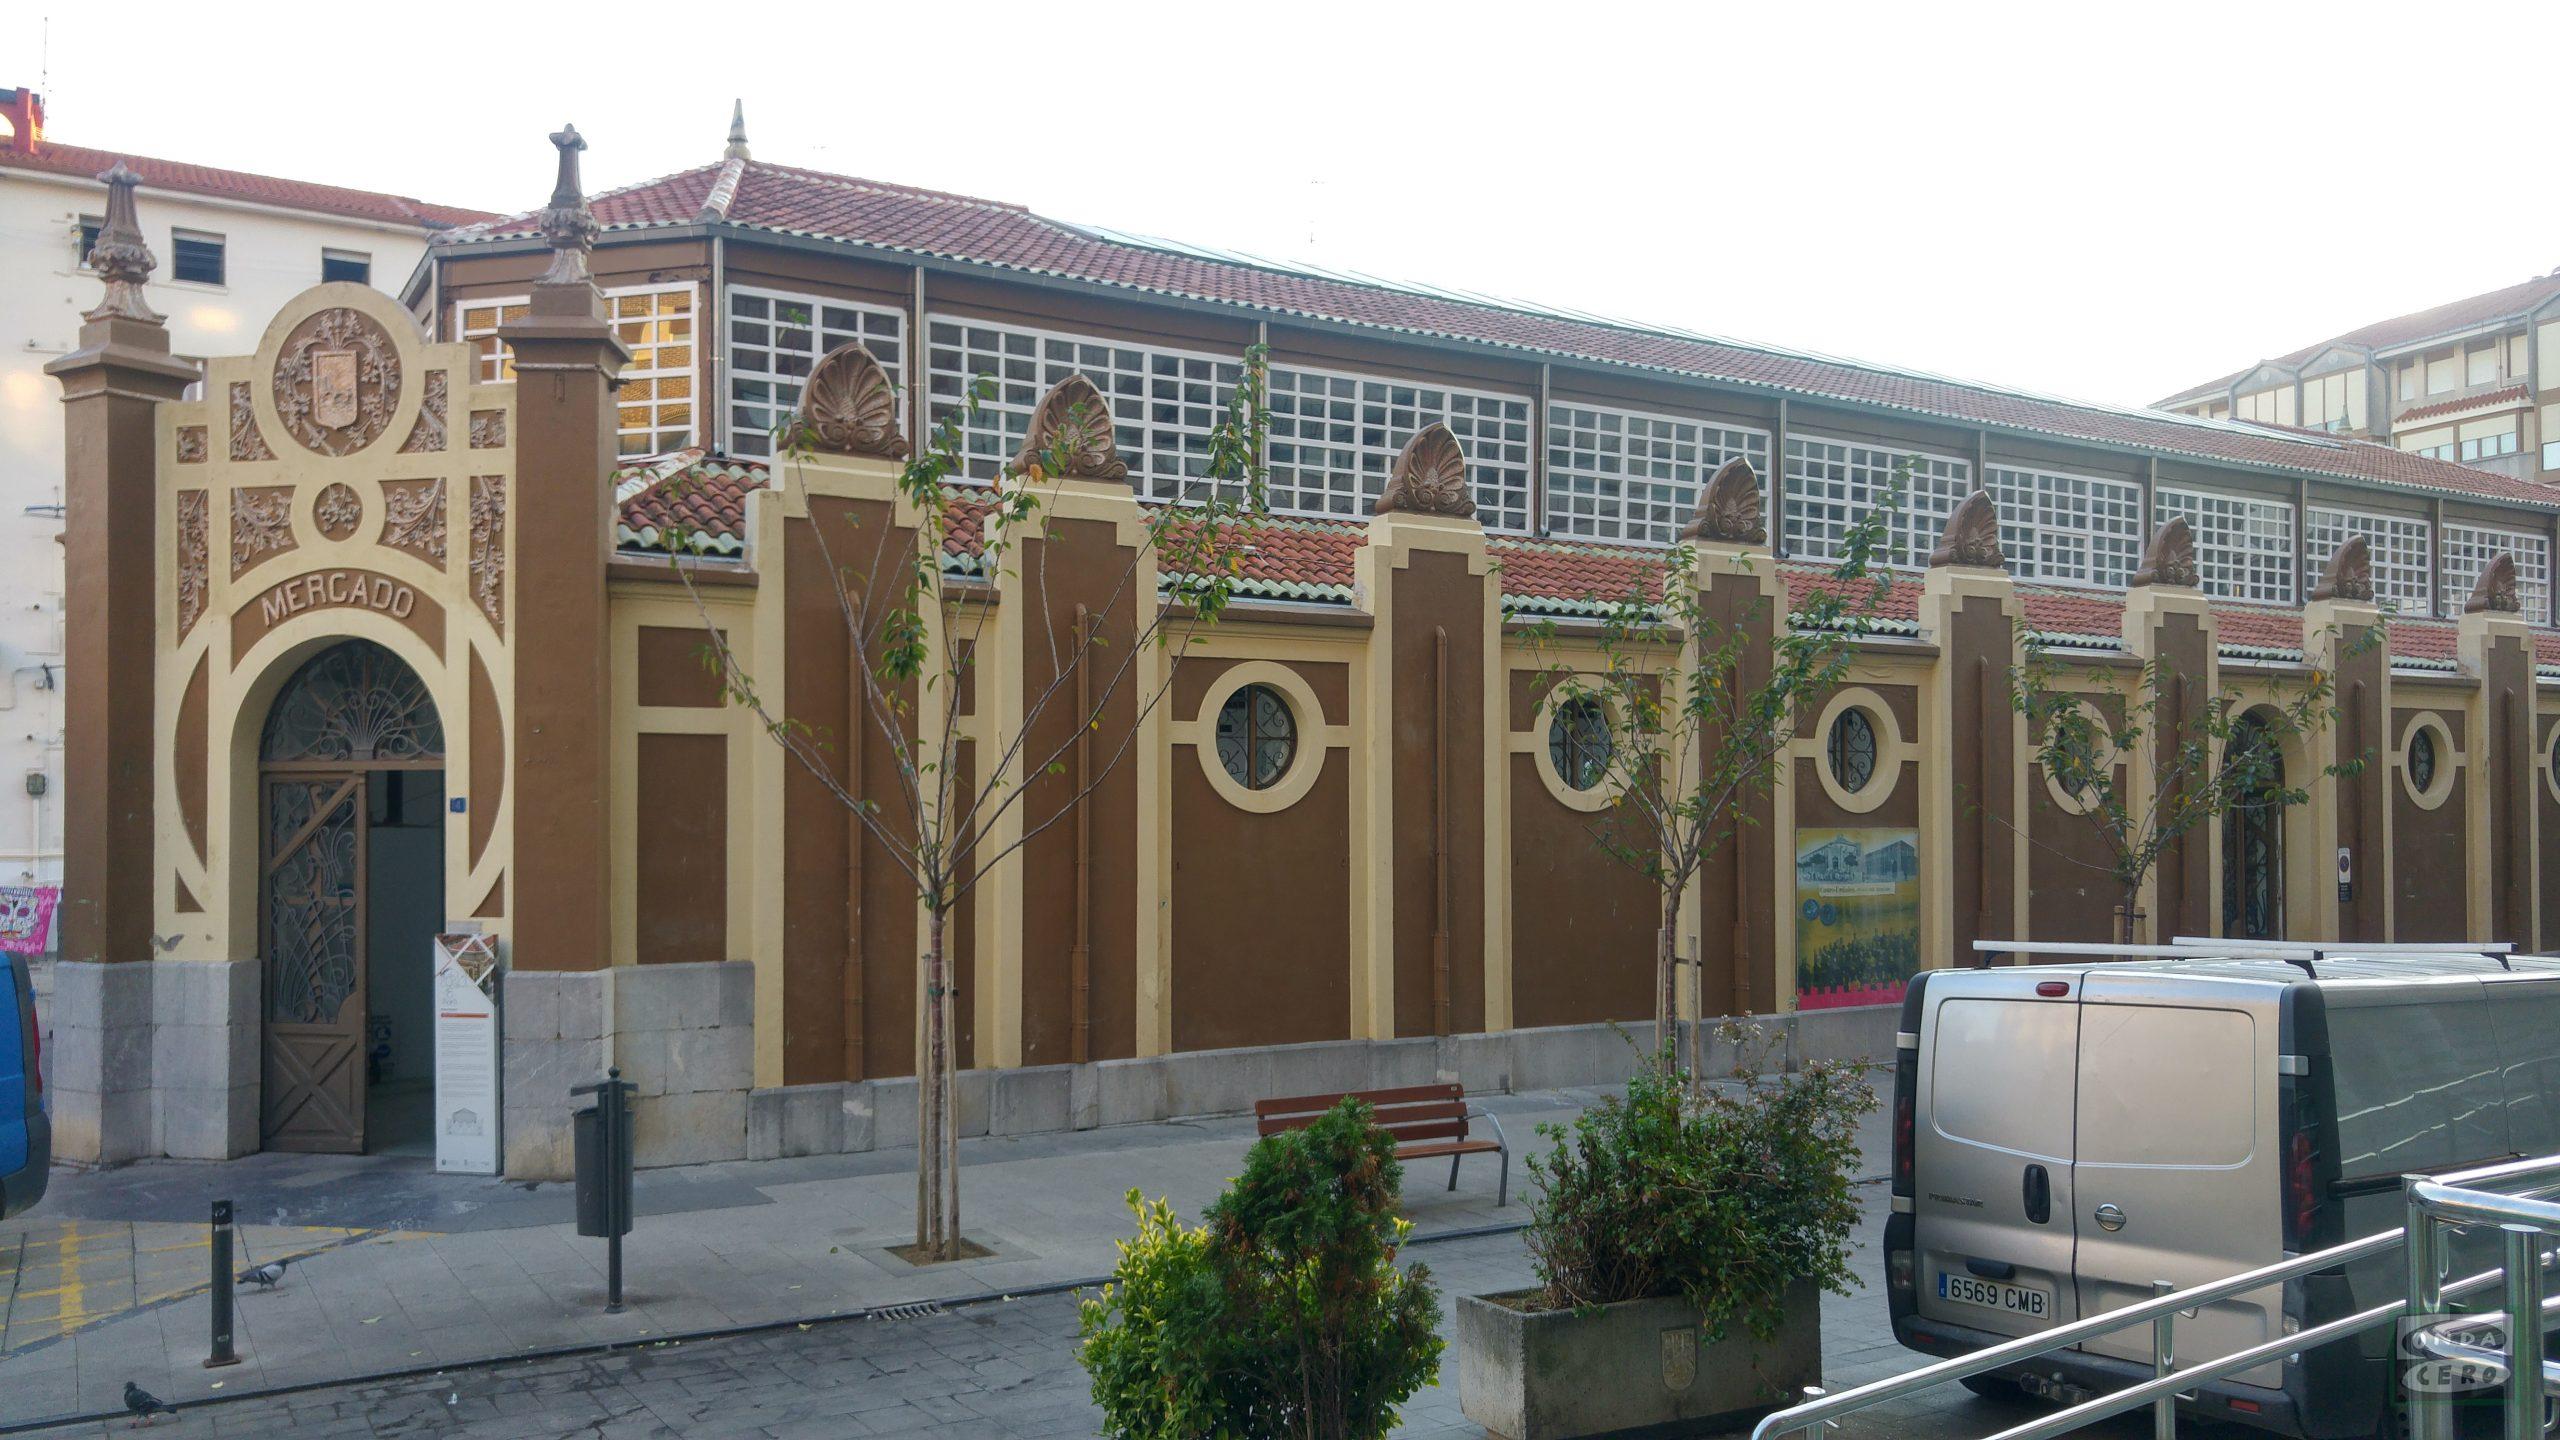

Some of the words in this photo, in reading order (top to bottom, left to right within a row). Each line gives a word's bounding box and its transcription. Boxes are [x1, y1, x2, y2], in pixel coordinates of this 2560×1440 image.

[262, 572, 414, 626] MERCADO
[1951, 1278, 1998, 1305] 6569
[2005, 1288, 2043, 1314] CMB
